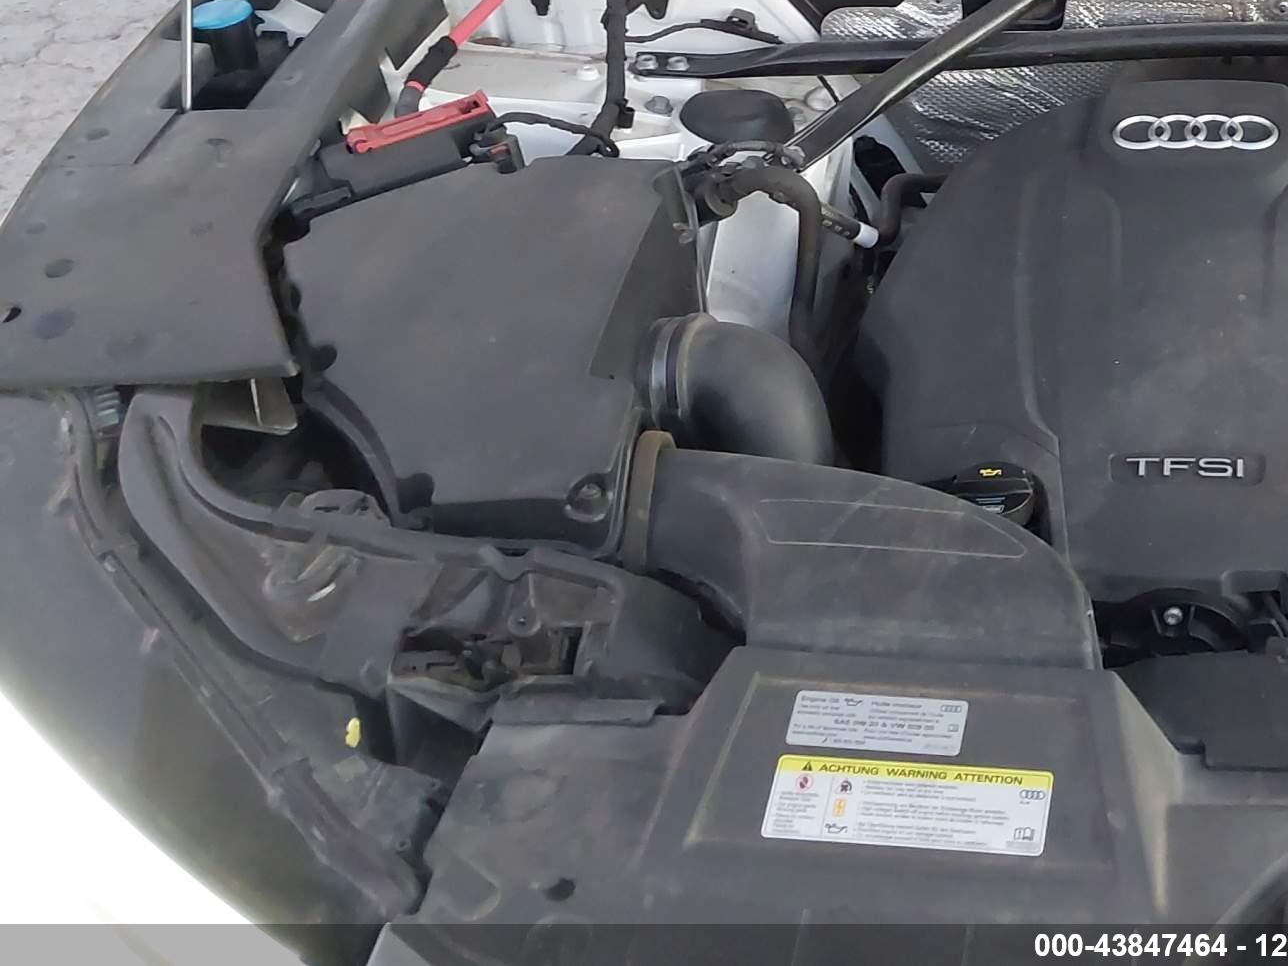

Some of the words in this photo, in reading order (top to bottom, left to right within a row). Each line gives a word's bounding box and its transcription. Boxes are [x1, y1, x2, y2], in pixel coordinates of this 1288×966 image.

[1126, 457, 1244, 477] TFSI
[819, 763, 880, 776] ACHTUNG
[886, 767, 948, 780] WARNING
[953, 772, 1023, 785] ATTENTION
